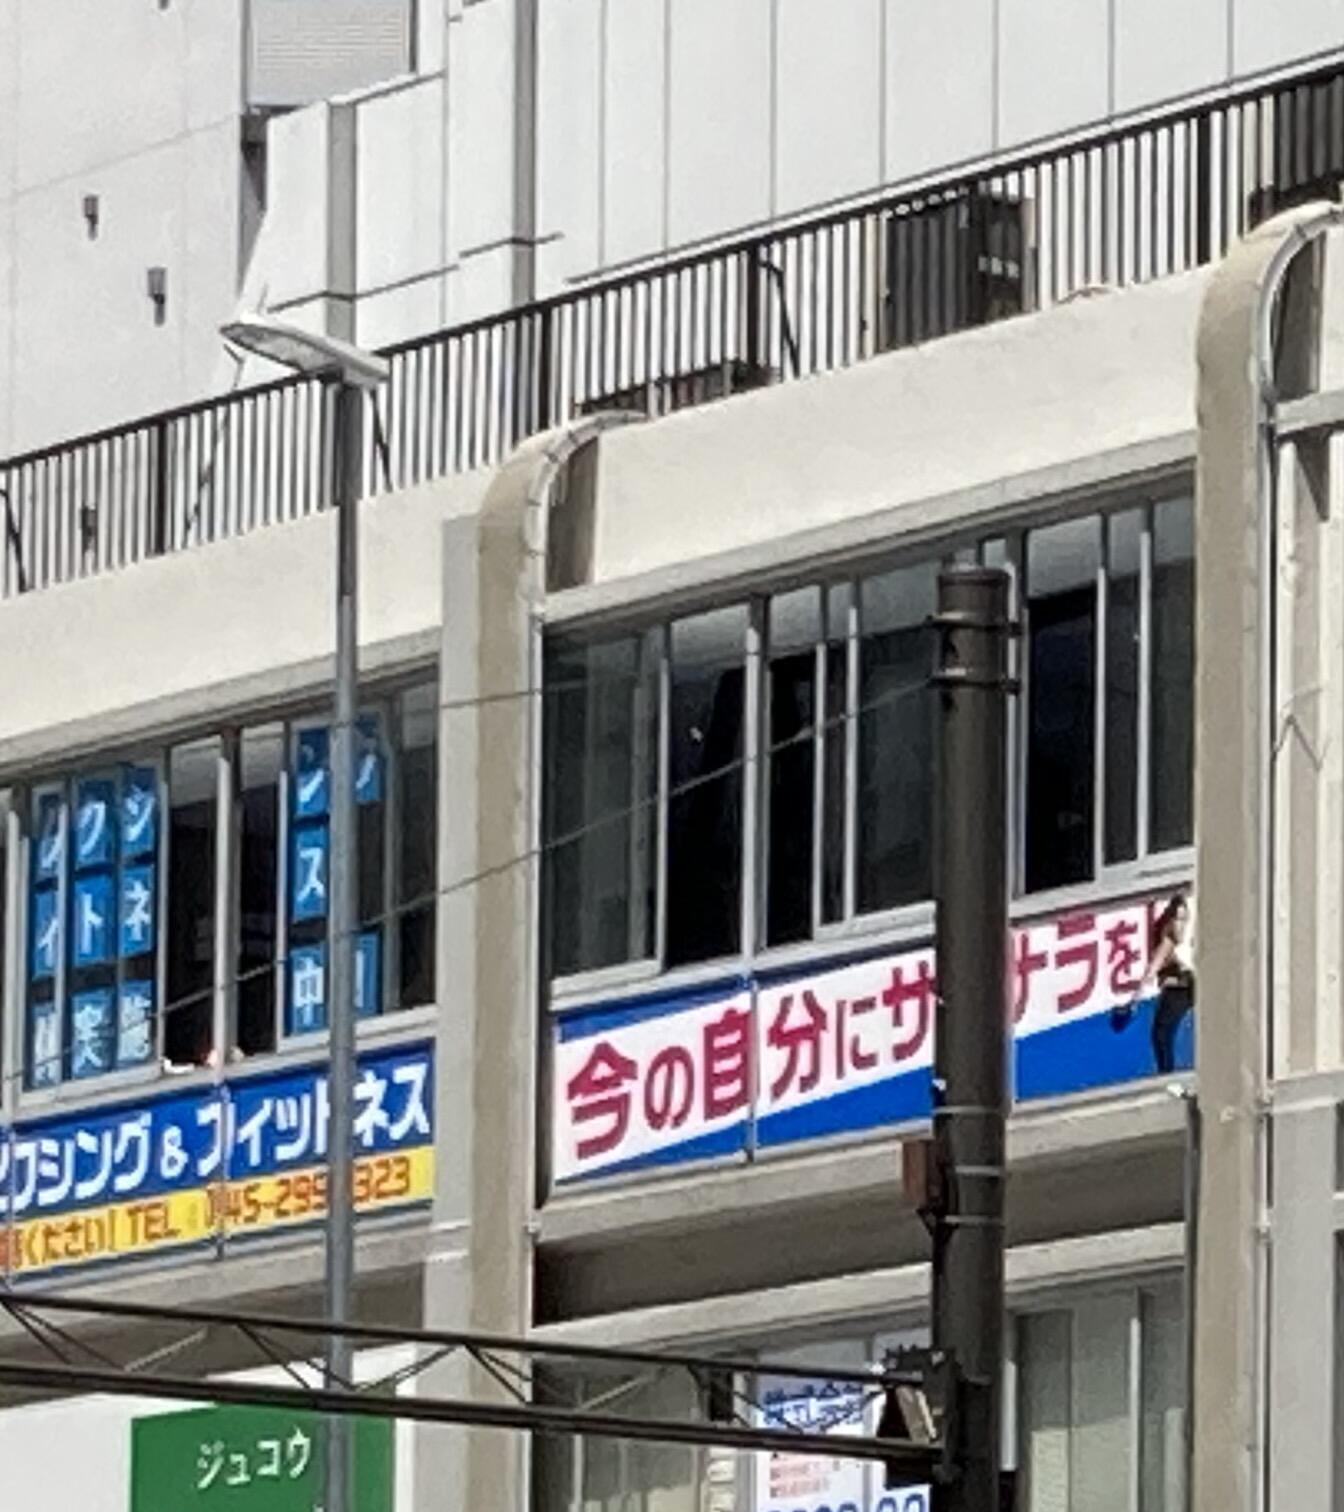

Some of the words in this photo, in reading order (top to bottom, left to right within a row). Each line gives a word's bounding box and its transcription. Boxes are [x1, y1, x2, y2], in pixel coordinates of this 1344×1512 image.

[567, 918, 1142, 1162] 今の自分にサナラを
[196, 1428, 312, 1490] ジュコウ
